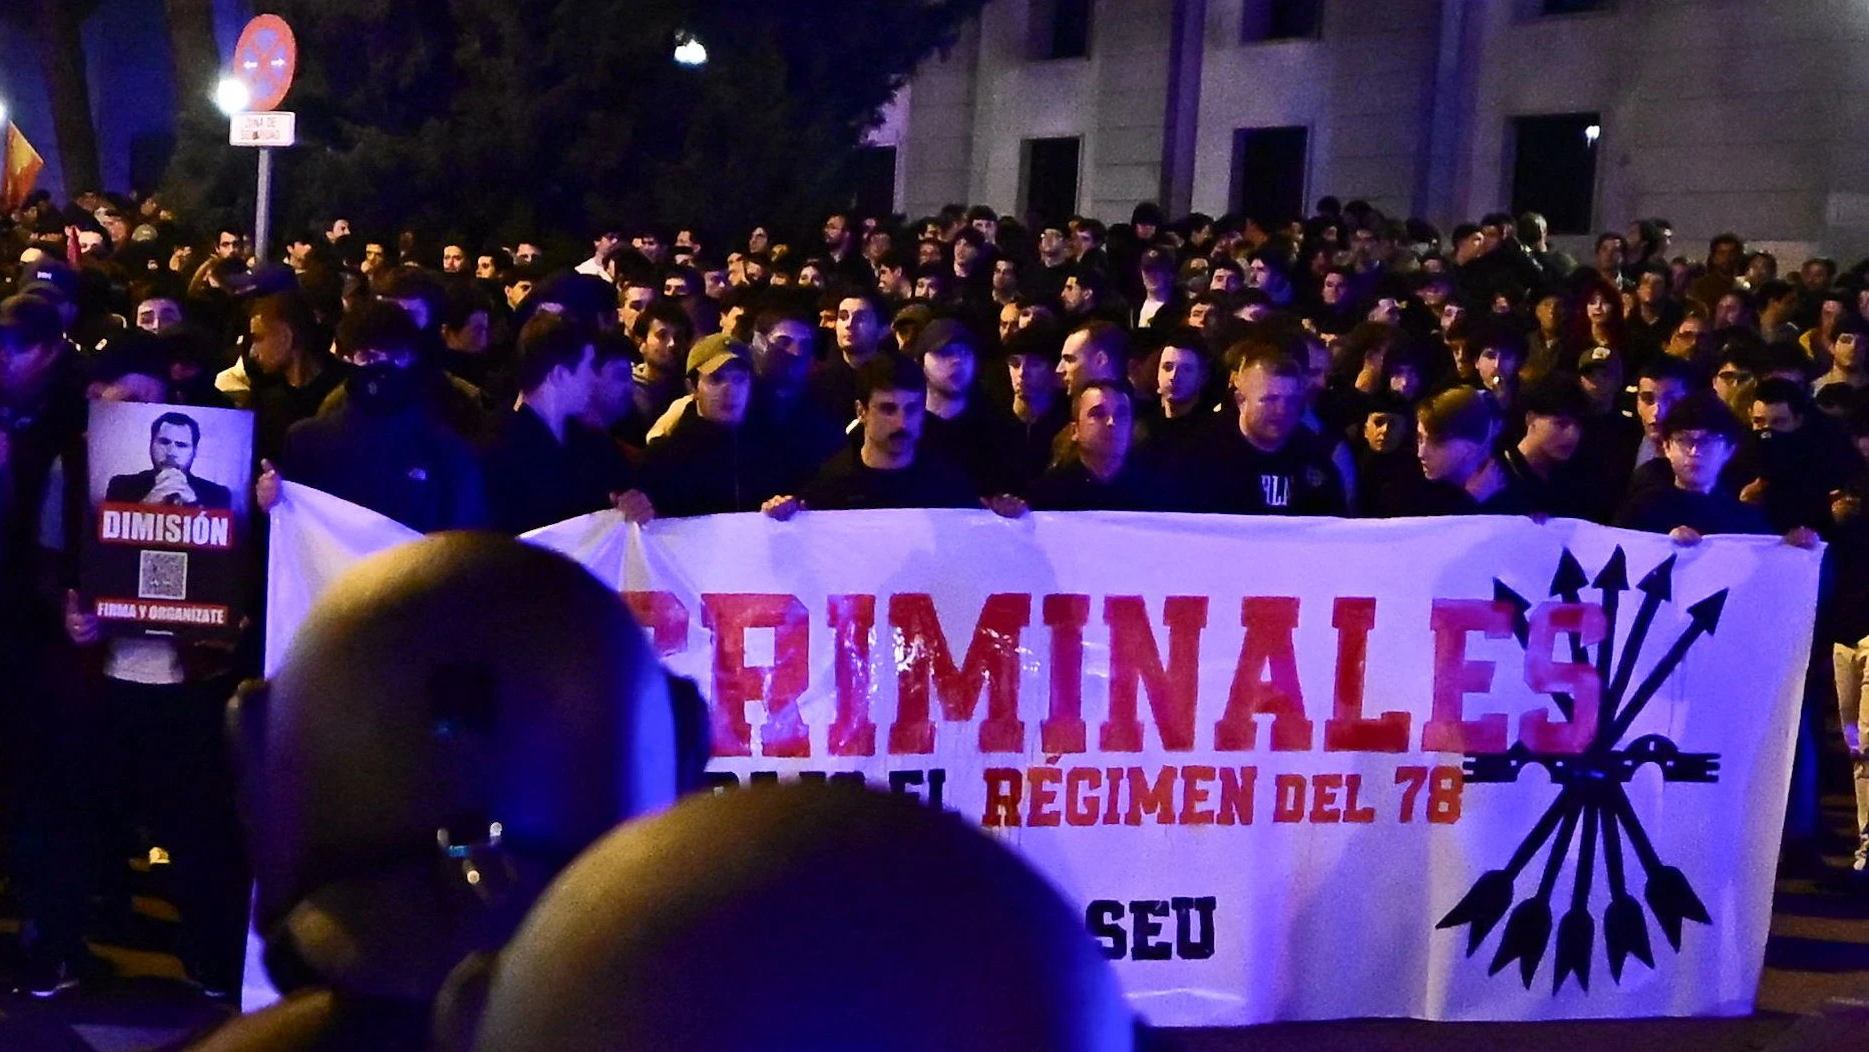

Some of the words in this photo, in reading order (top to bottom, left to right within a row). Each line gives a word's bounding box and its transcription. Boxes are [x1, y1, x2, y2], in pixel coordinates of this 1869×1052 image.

[102, 508, 229, 547] DIMISIÓN
[96, 602, 137, 619] FIRMA
[138, 604, 148, 620] Y
[982, 753, 1257, 827] RÉGIMEN
[1274, 773, 1375, 824] DEL
[1395, 767, 1463, 826] 78
[1086, 896, 1217, 961] SEU
